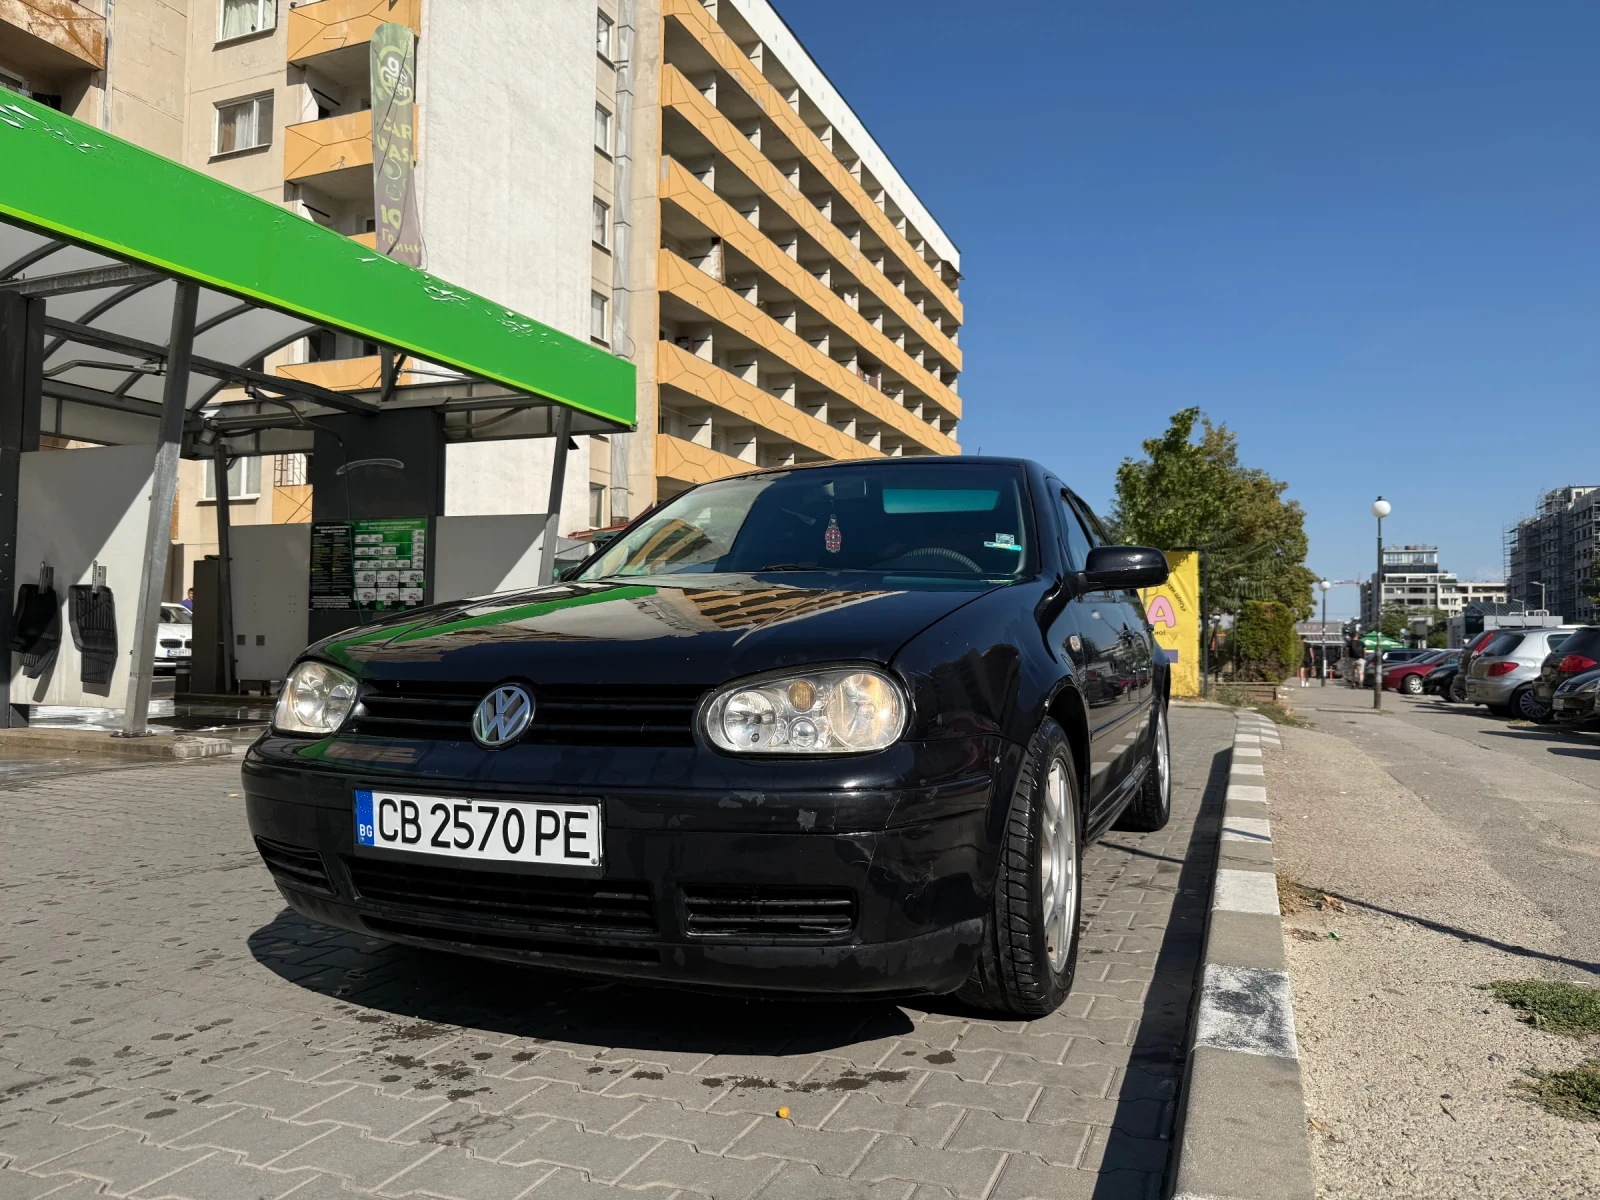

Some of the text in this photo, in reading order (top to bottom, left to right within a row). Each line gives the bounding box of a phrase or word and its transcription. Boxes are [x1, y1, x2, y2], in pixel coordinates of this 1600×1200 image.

[383, 116, 412, 141] CAR
[380, 204, 402, 230] 10
[381, 227, 421, 253] ГОИНИ
[359, 823, 373, 838] BG
[378, 798, 590, 859] CB 2570 PE
